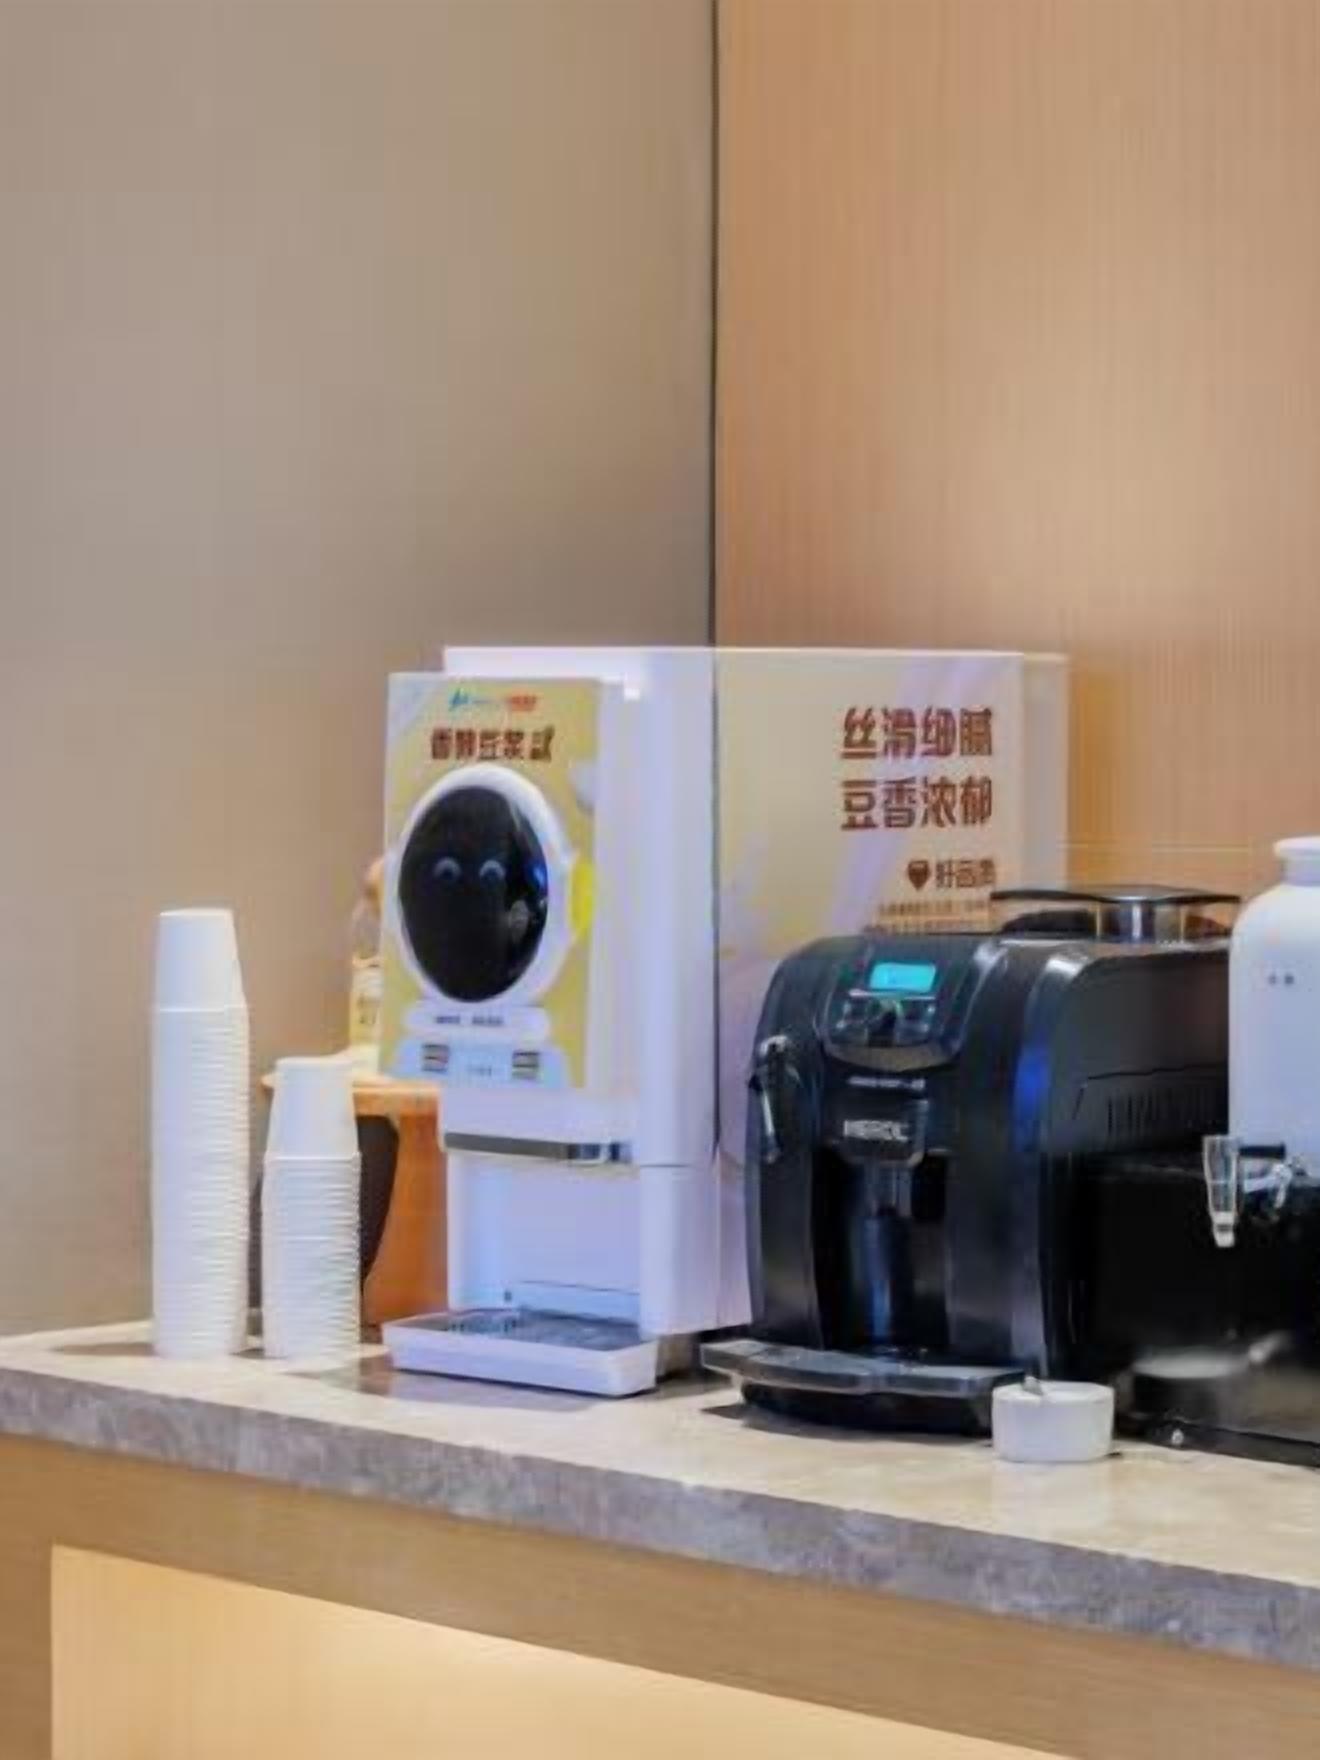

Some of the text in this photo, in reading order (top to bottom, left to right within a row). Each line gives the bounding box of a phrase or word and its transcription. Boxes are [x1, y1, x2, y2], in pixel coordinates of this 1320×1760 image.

[840, 705, 993, 759] 丝滑细腻
[840, 775, 993, 831] 豆香浓郁
